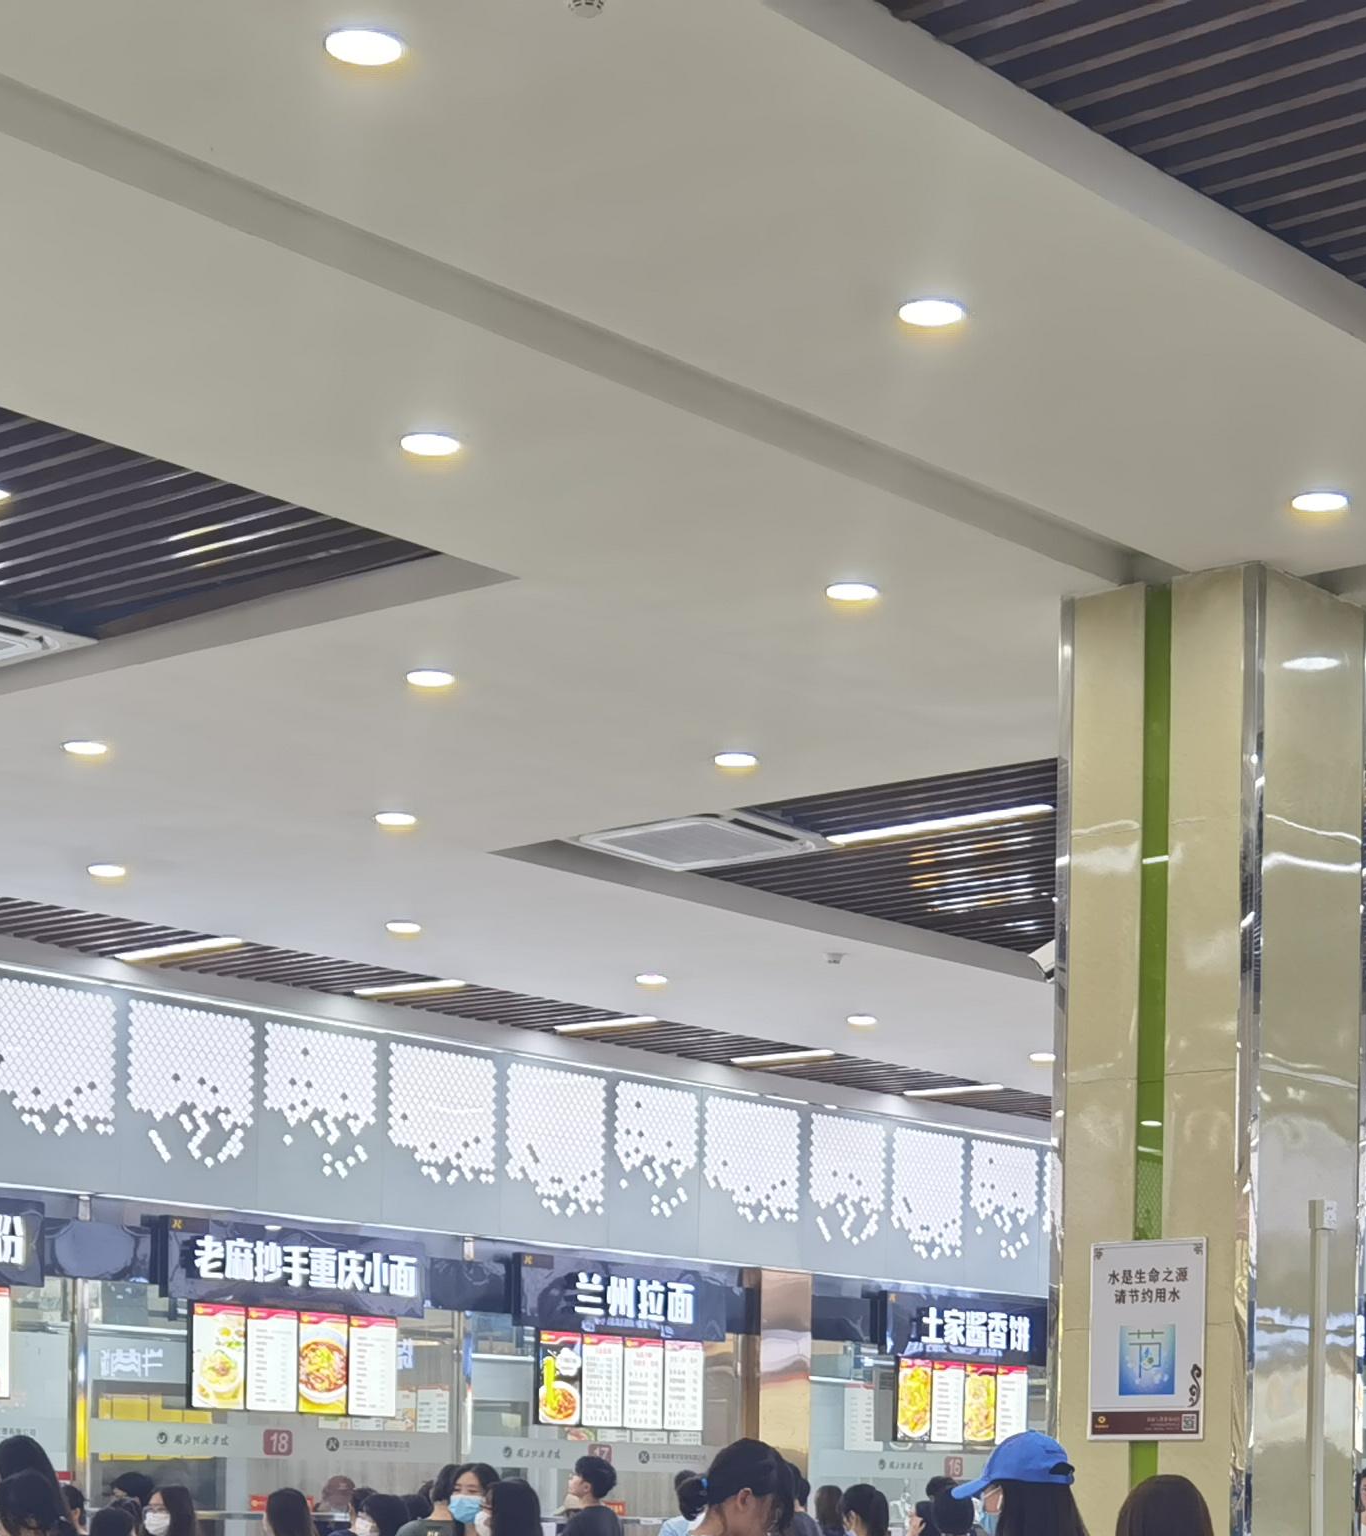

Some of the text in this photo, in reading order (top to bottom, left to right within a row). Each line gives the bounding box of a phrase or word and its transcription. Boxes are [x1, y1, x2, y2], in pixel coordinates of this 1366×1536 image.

[194, 1234, 417, 1297] 老麻抄手重庆小面
[1108, 1267, 1189, 1285] 水是生命之源
[574, 1272, 696, 1325] 兰州拉面
[1114, 1287, 1180, 1304] 请节约用水
[921, 1306, 1031, 1352] 土家酱香饼
[269, 1432, 289, 1452] 18
[949, 1460, 962, 1476] 16
